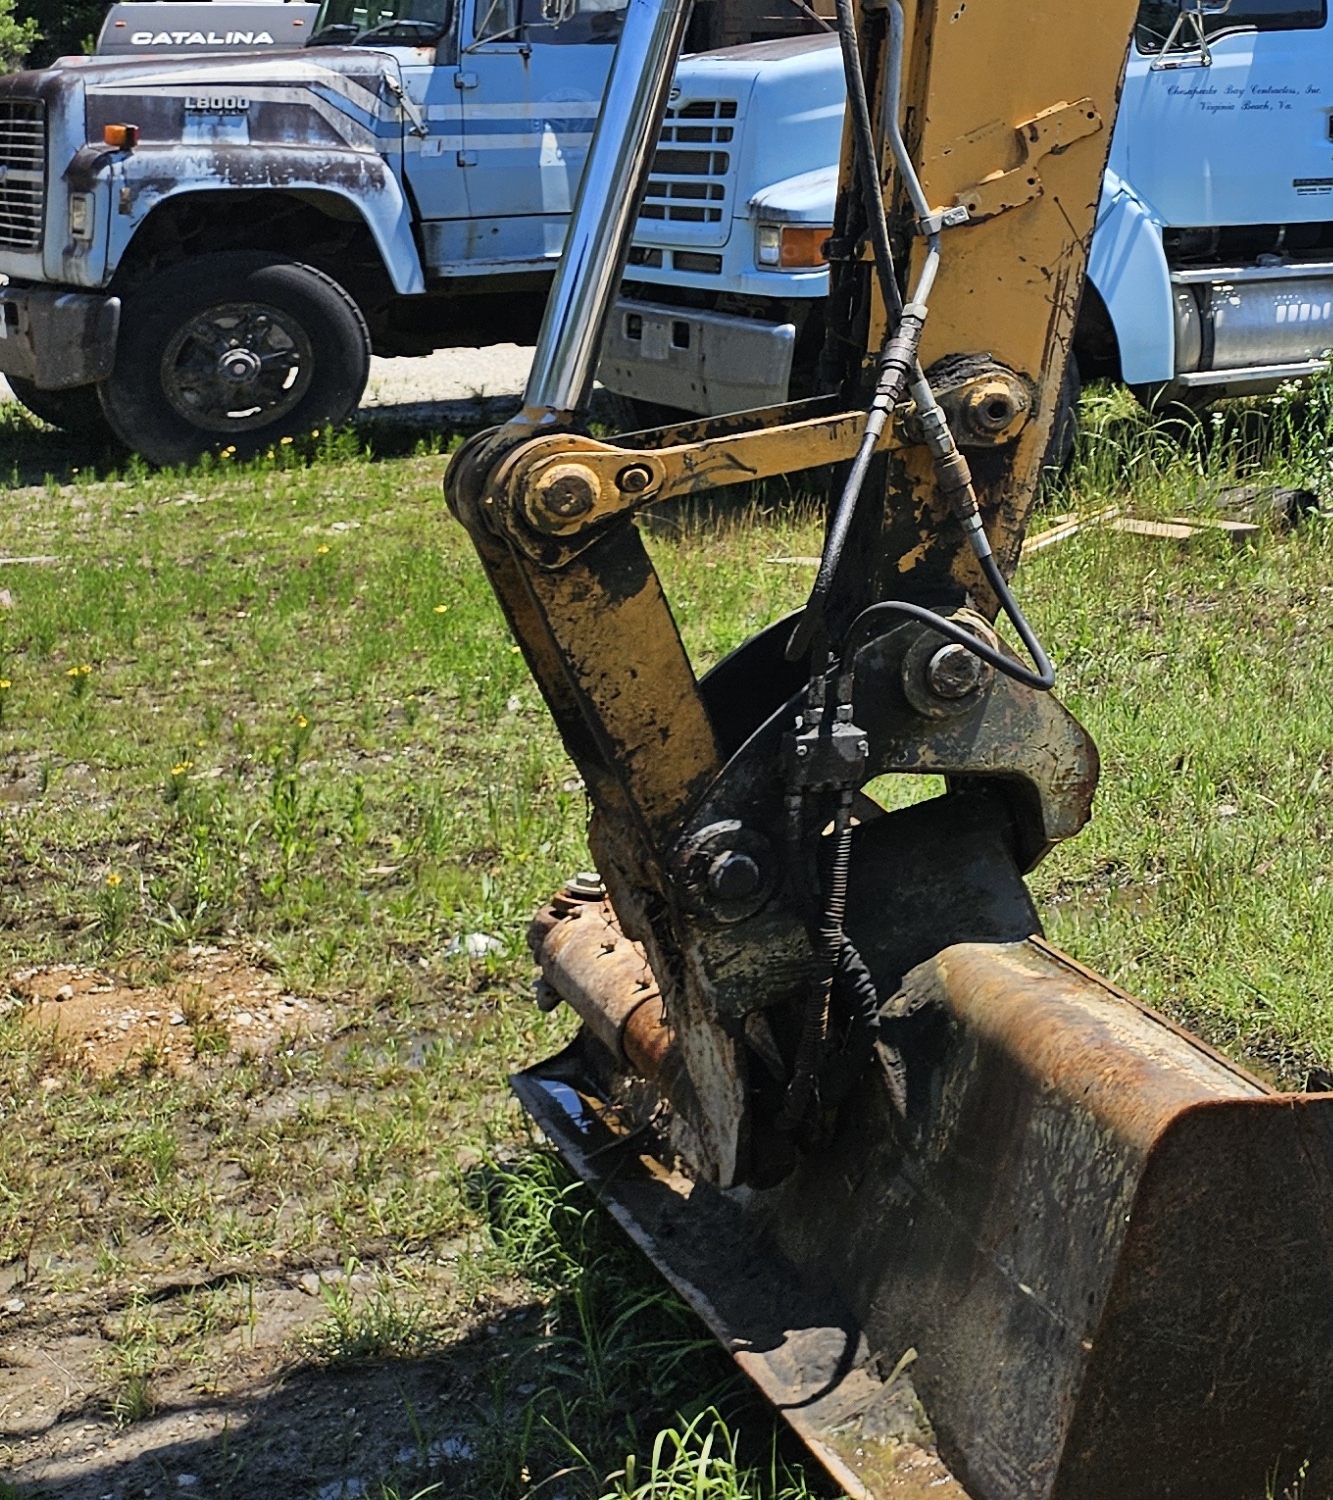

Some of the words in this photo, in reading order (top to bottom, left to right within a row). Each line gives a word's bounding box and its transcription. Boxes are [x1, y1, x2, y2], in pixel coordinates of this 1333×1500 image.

[130, 31, 275, 45] CATALINA
[1168, 85, 1218, 99] Chesapeake
[1223, 84, 1245, 98] Bay
[1304, 85, 1322, 95] Inc.
[184, 96, 250, 110] L8000
[1200, 101, 1235, 114] Virginia
